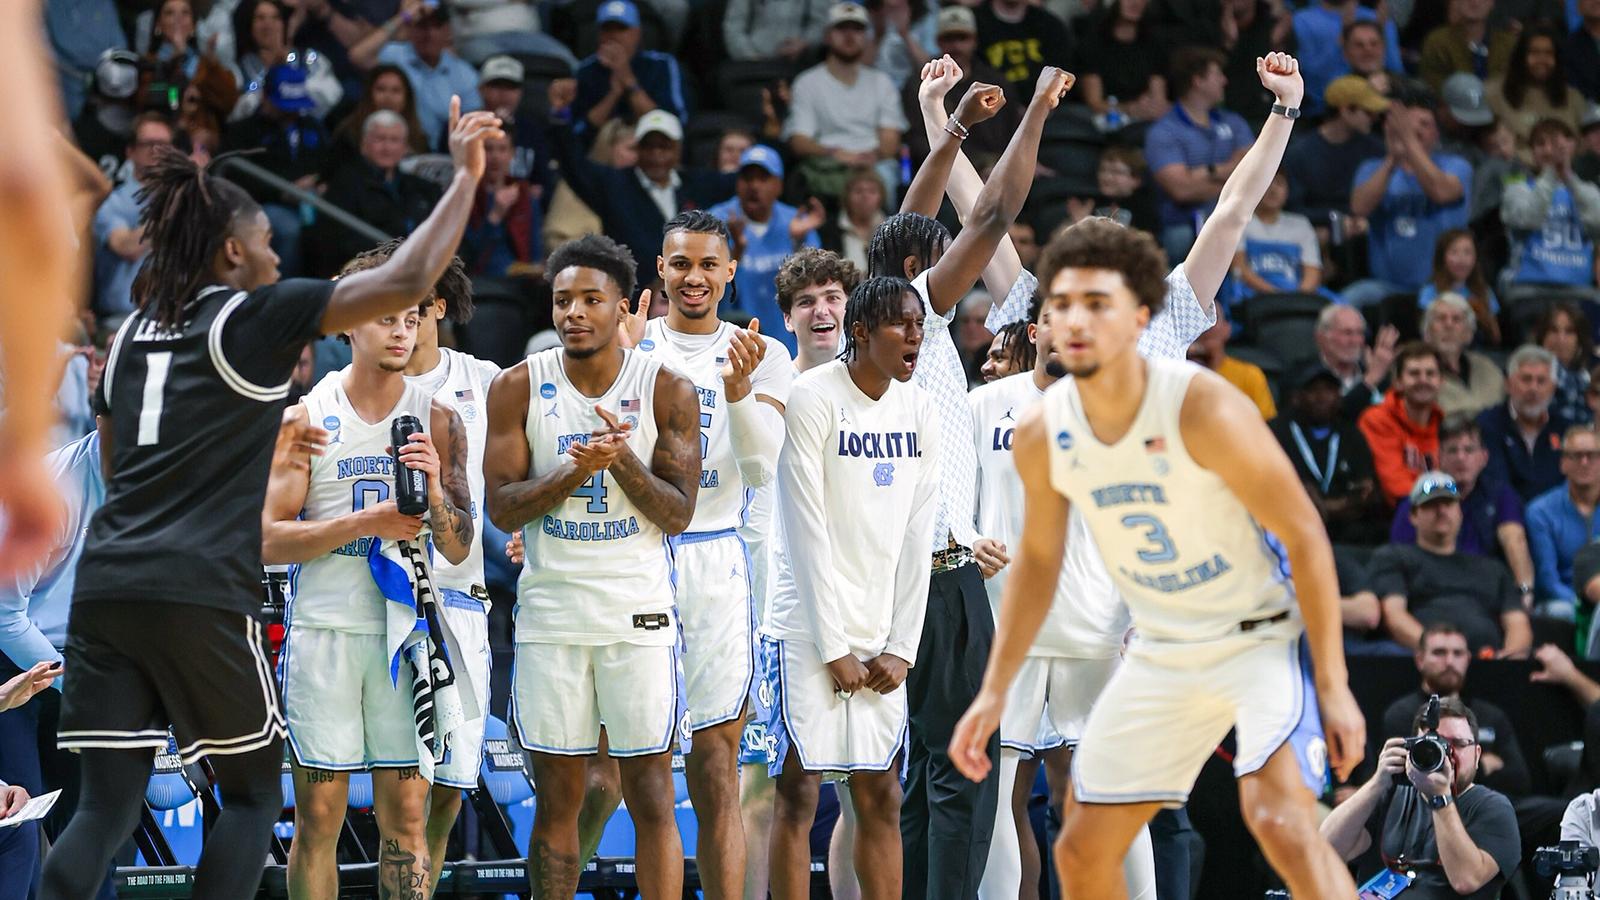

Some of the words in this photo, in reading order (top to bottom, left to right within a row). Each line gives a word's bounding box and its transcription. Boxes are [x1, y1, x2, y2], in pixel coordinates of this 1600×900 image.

[137, 352, 173, 446] 1
[838, 430, 885, 459] LOCK
[885, 432, 903, 458] IT
[337, 456, 397, 480] NORT
[542, 515, 640, 542] CAROLINA
[1121, 514, 1177, 565] 3
[154, 754, 182, 769] MADNESS
[493, 753, 524, 767] MADNESS
[306, 771, 334, 783] 1969
[127, 877, 137, 886] THE
[137, 876, 148, 885] ROAD
[154, 875, 163, 884] THE
[163, 875, 175, 884] FINAL
[175, 874, 186, 883] FOUR
